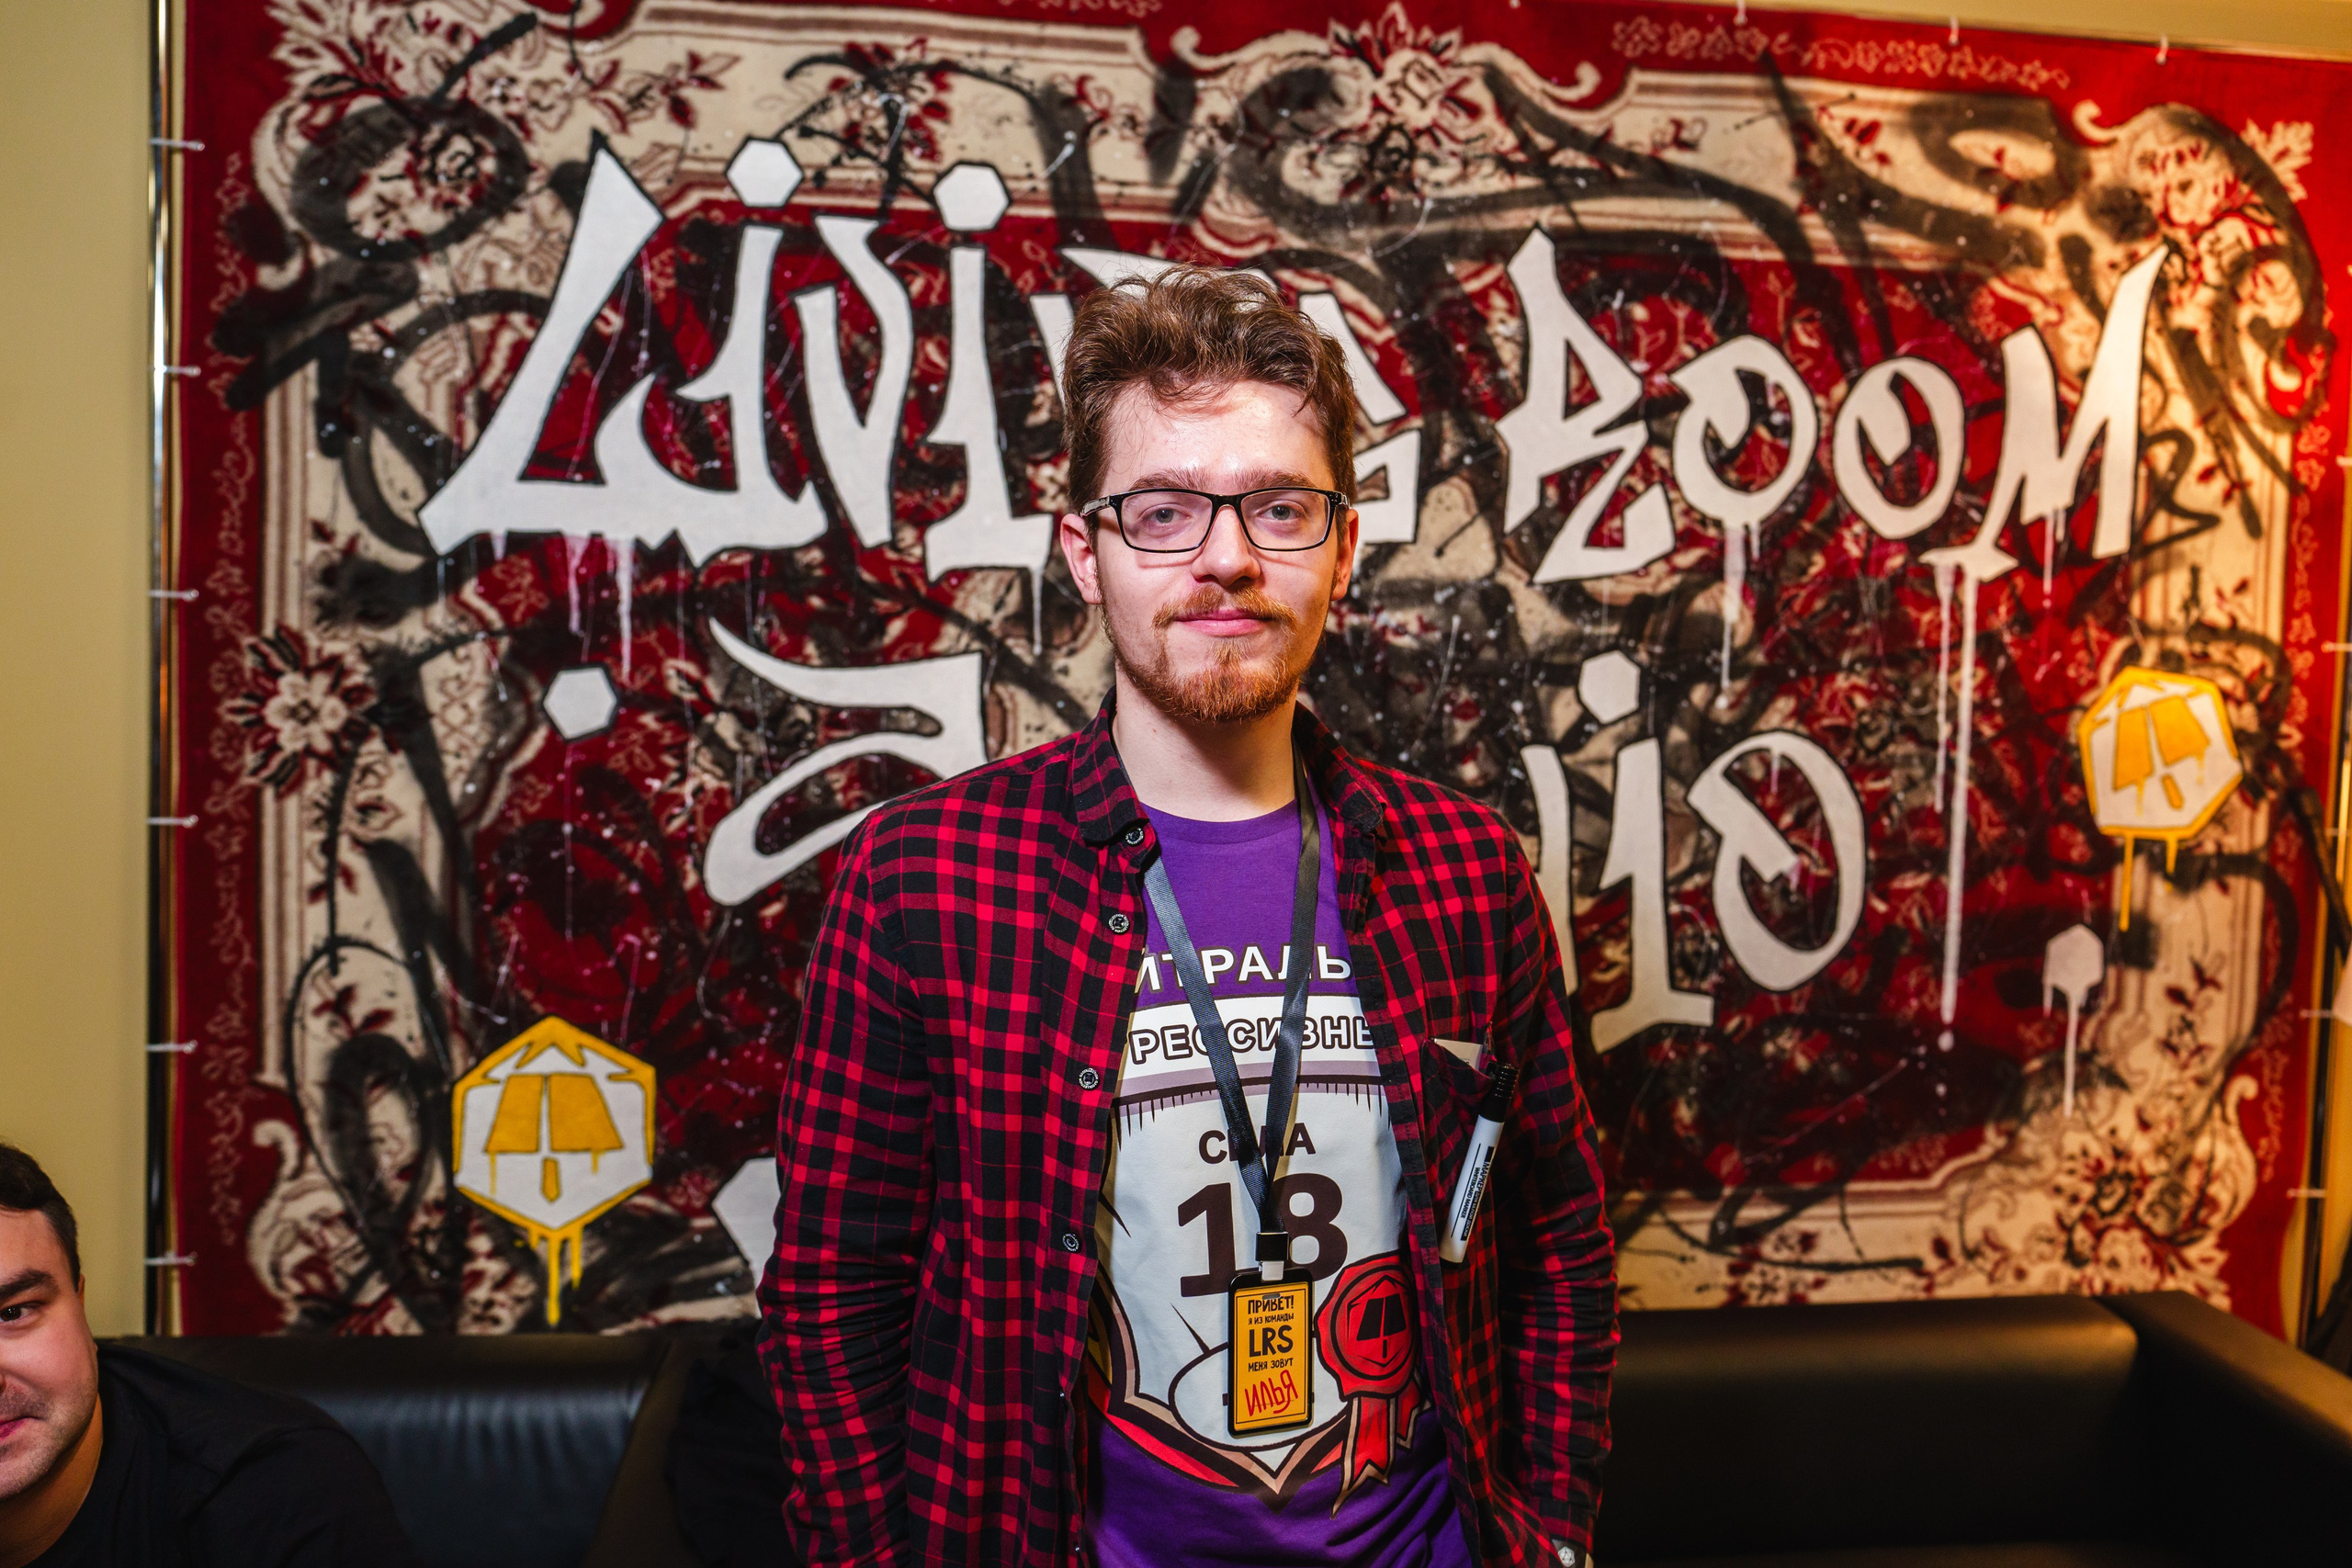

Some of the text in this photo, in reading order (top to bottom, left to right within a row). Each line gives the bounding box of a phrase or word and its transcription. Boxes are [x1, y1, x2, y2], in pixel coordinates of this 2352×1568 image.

[1497, 228, 2168, 584] ROOM
[1459, 1166, 1481, 1219] WHITEBOARD MARKER
[1474, 1161, 1490, 1192] МАРКЕР
[1177, 1173, 1348, 1297] 18
[1248, 1294, 1295, 1315] ПРИВЕТ!
[1254, 1316, 1263, 1325] ИЗ
[1264, 1313, 1295, 1324] КОМАНДЫ
[1249, 1325, 1294, 1358] LRS
[1248, 1357, 1294, 1372] МЕНЯ ЗОВУТ
[1244, 1369, 1299, 1417] ИЛЬЯ
